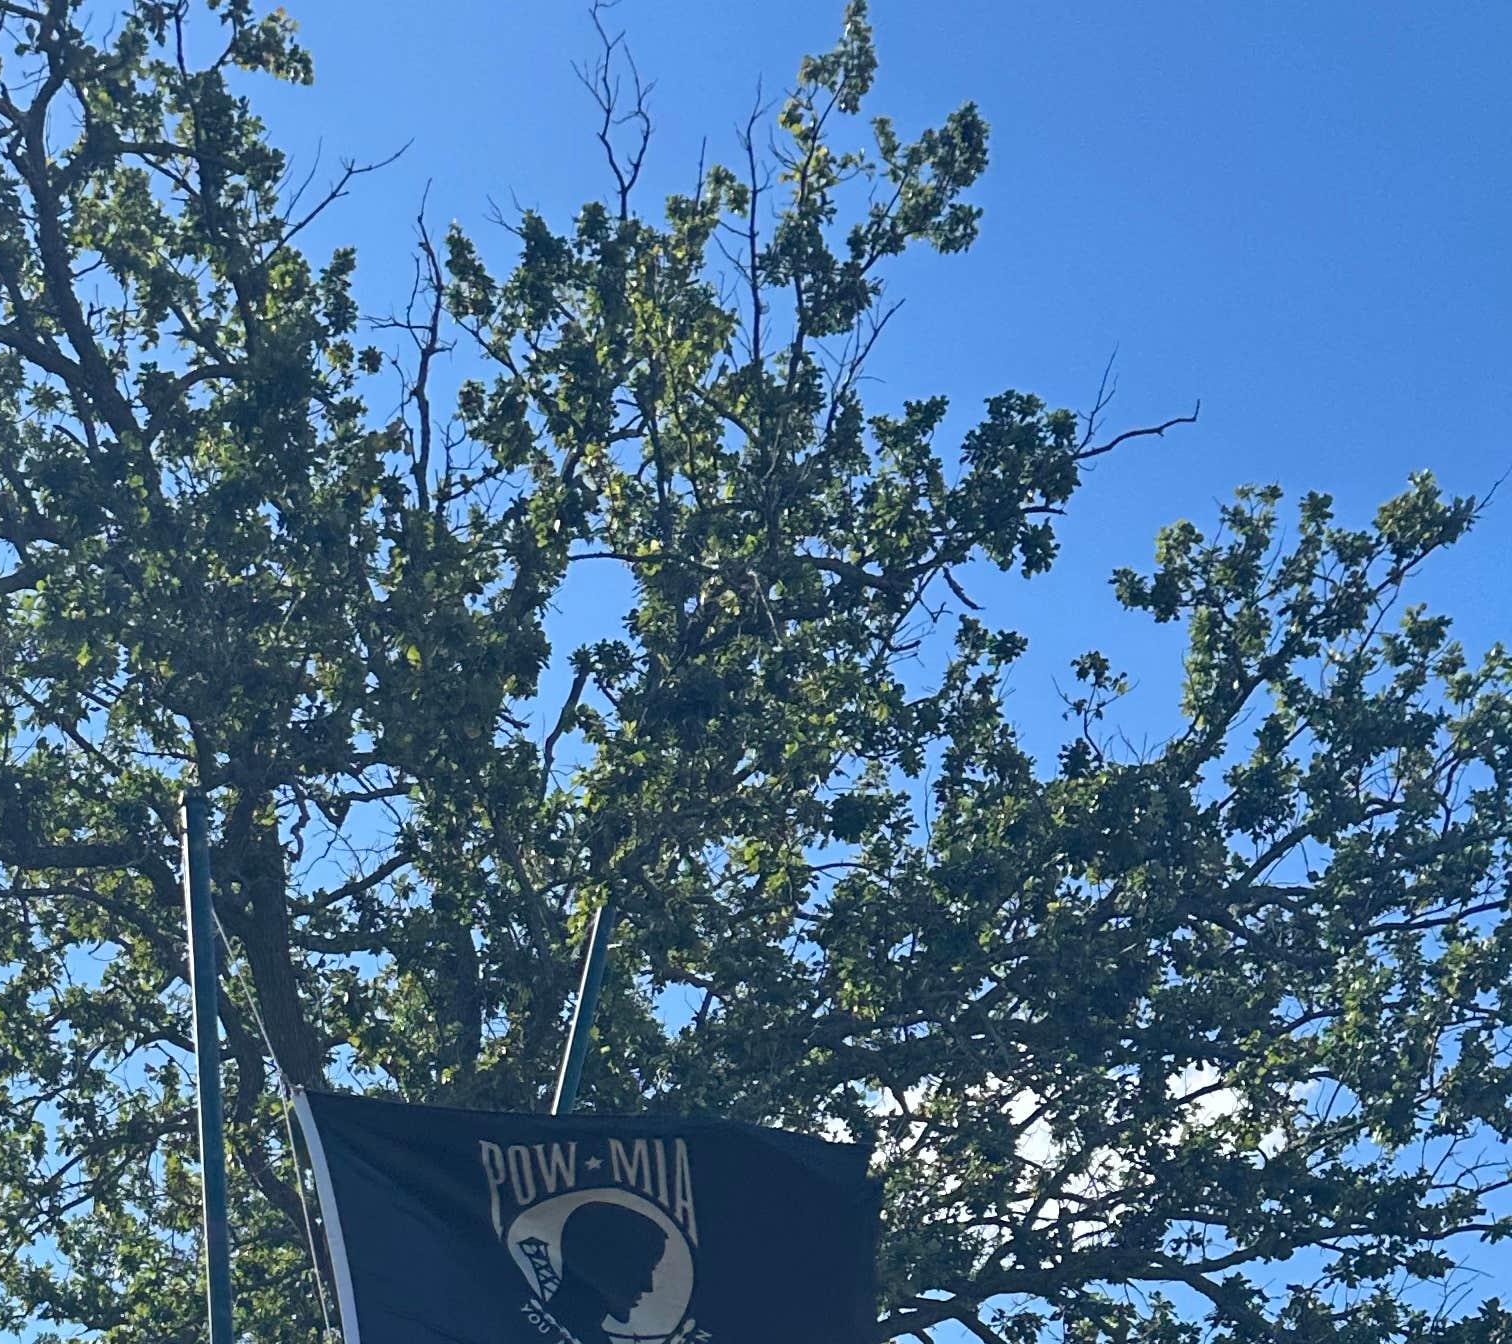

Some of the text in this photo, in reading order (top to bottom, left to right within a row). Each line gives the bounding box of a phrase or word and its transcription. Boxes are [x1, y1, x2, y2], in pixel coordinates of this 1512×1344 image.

[479, 1137, 698, 1246] POW MIA
[521, 1305, 550, 1333] YOU
